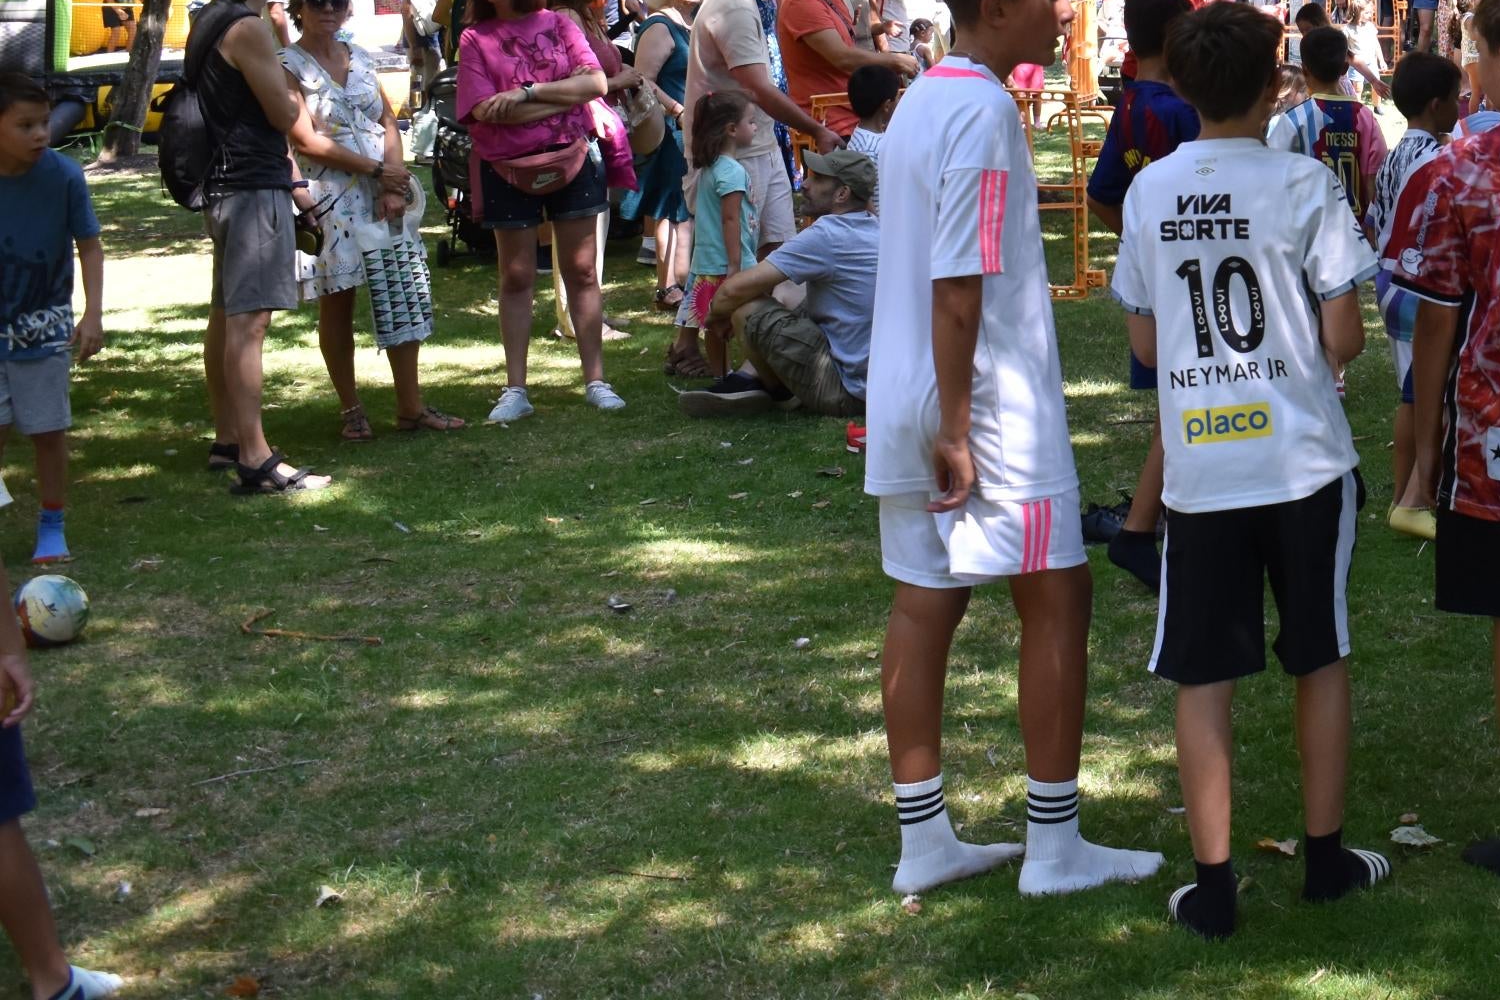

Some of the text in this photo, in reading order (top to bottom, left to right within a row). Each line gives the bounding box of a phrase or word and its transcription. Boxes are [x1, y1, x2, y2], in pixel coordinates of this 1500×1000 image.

[1325, 132, 1358, 147] MESSI
[1177, 193, 1231, 215] VIVA
[1160, 219, 1249, 242] SORTE
[1175, 256, 1265, 358] 10
[1169, 357, 1288, 389] NEYMAR JR
[1187, 409, 1268, 444] placo
